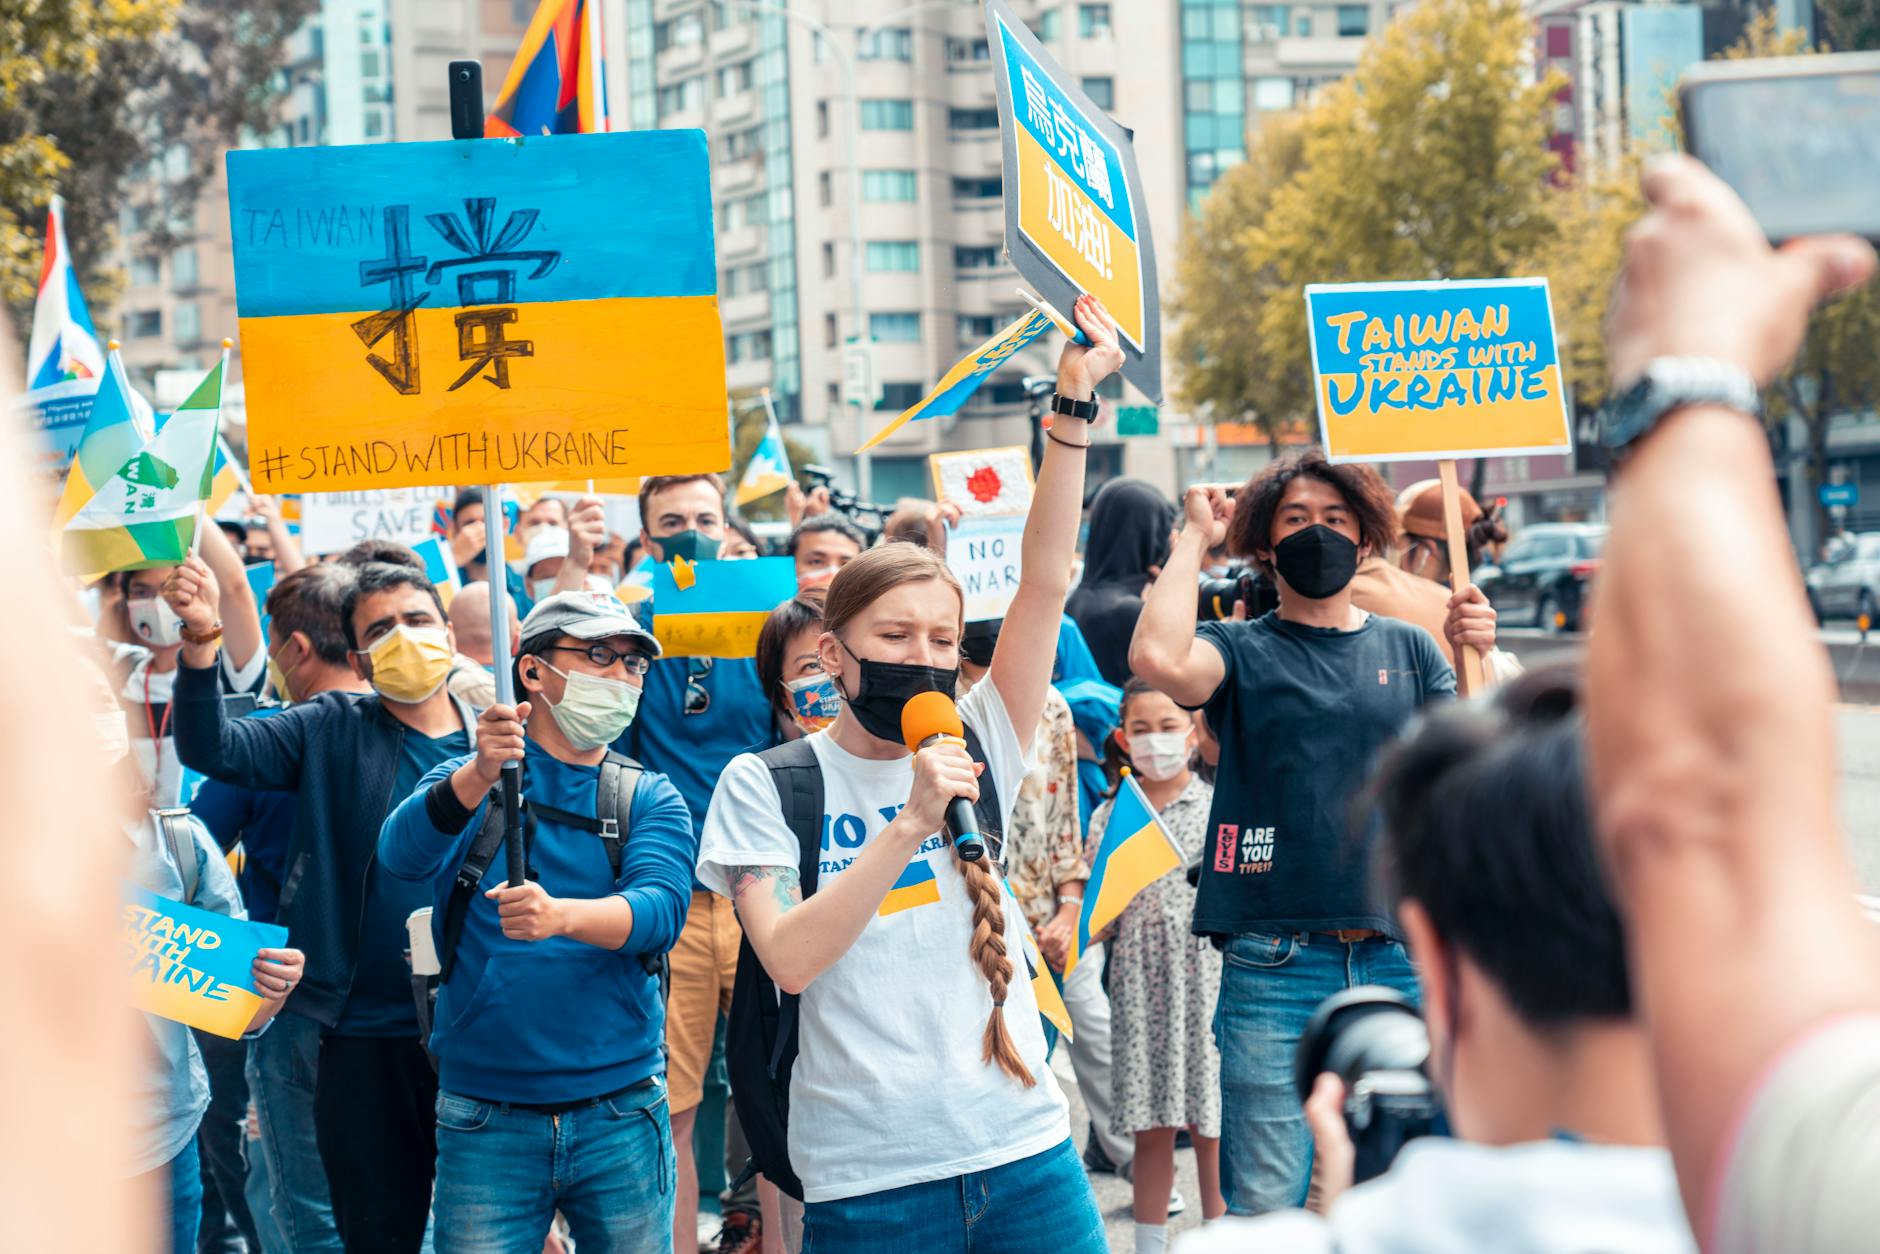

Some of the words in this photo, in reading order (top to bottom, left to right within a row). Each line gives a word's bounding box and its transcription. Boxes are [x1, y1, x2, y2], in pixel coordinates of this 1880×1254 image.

[1021, 66, 1113, 209] 烏克蘭
[246, 205, 376, 248] TAIWAN
[350, 198, 562, 395] 撐
[1326, 304, 1509, 354] TAIWAN
[1359, 347, 1459, 374] STANDS
[1467, 341, 1536, 366] WITH
[1329, 365, 1548, 415] UKRAINE
[125, 461, 139, 514] WAN
[351, 507, 424, 541] SAVE
[969, 539, 1005, 560] NO
[966, 565, 1019, 593] WAR
[1241, 845, 1274, 863] YOU
[1242, 827, 1276, 846] ARE
